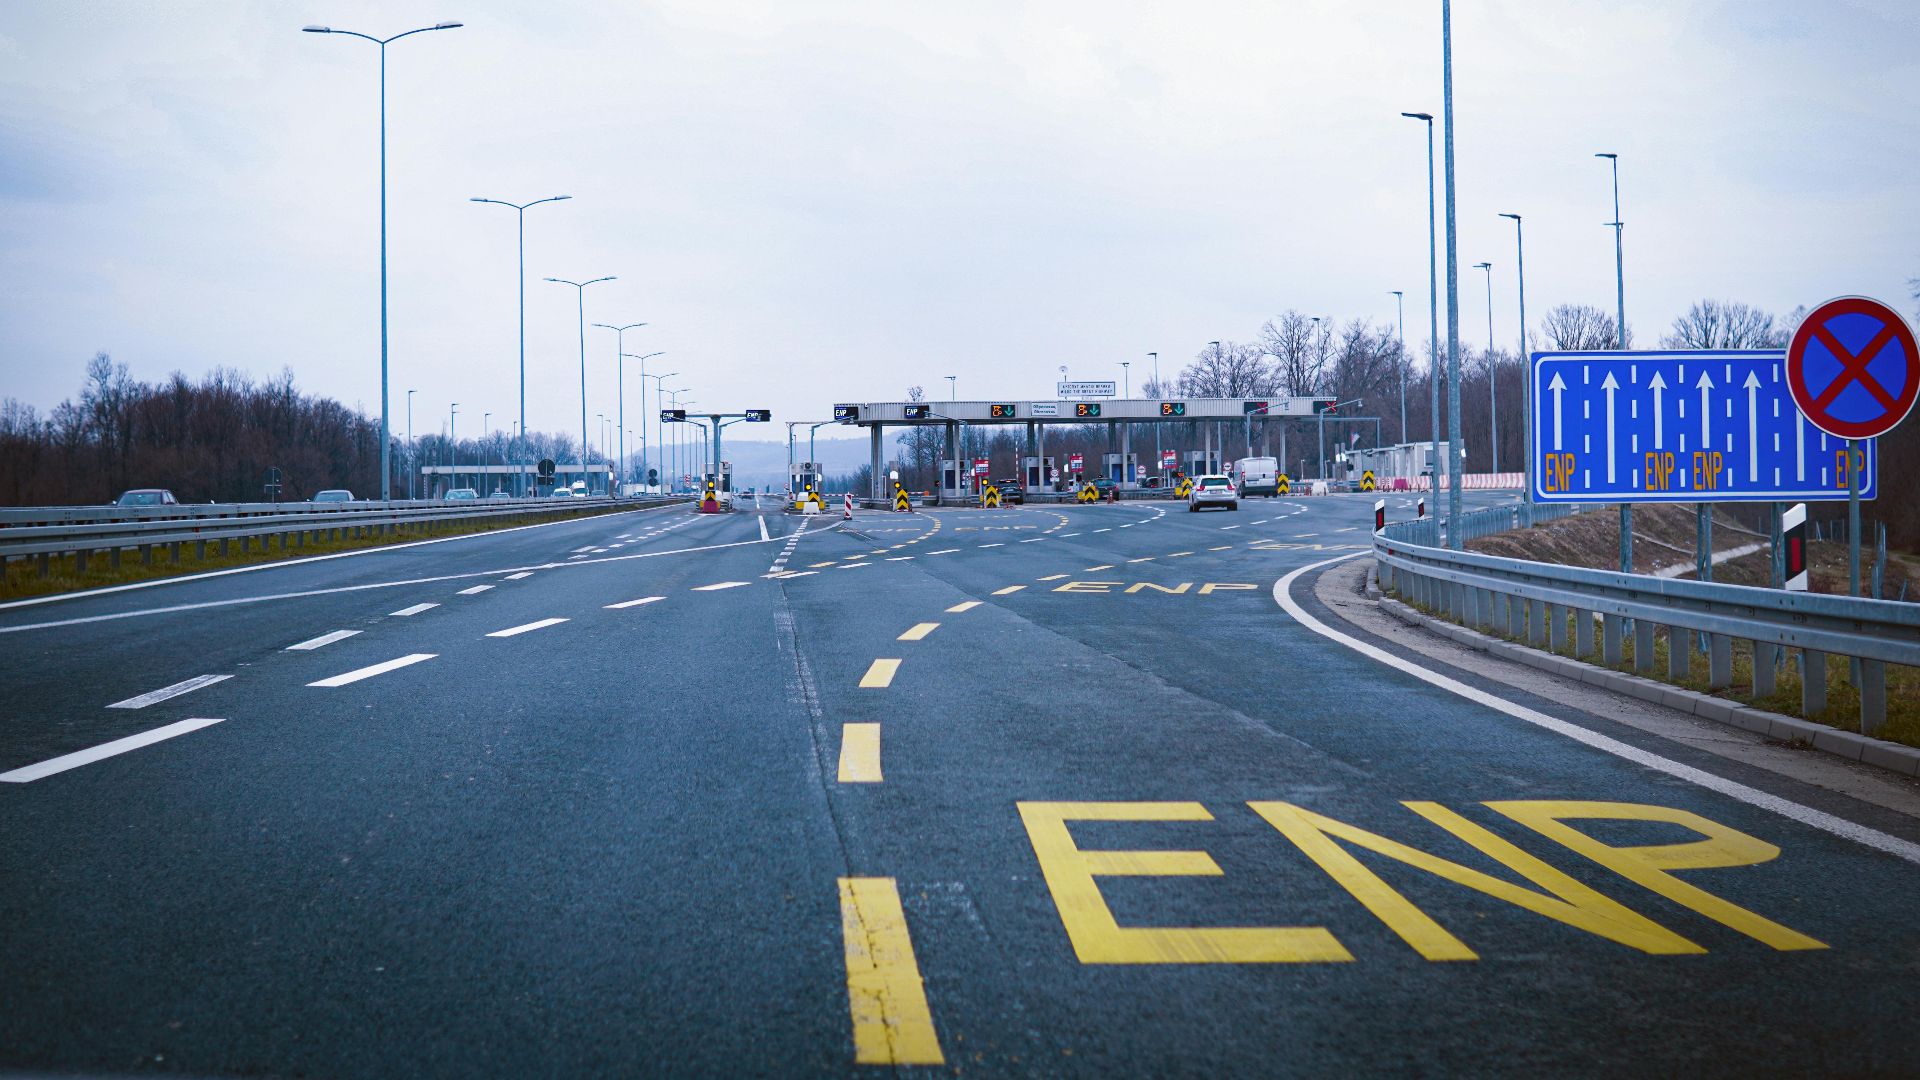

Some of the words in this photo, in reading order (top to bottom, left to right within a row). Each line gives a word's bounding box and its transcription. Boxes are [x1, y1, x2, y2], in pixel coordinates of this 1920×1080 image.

[1546, 453, 1575, 492] ENP
[1645, 452, 1675, 490] ENP
[1693, 451, 1723, 490] ENP
[1051, 581, 1259, 594] ENP
[1016, 800, 1831, 965] ENP
